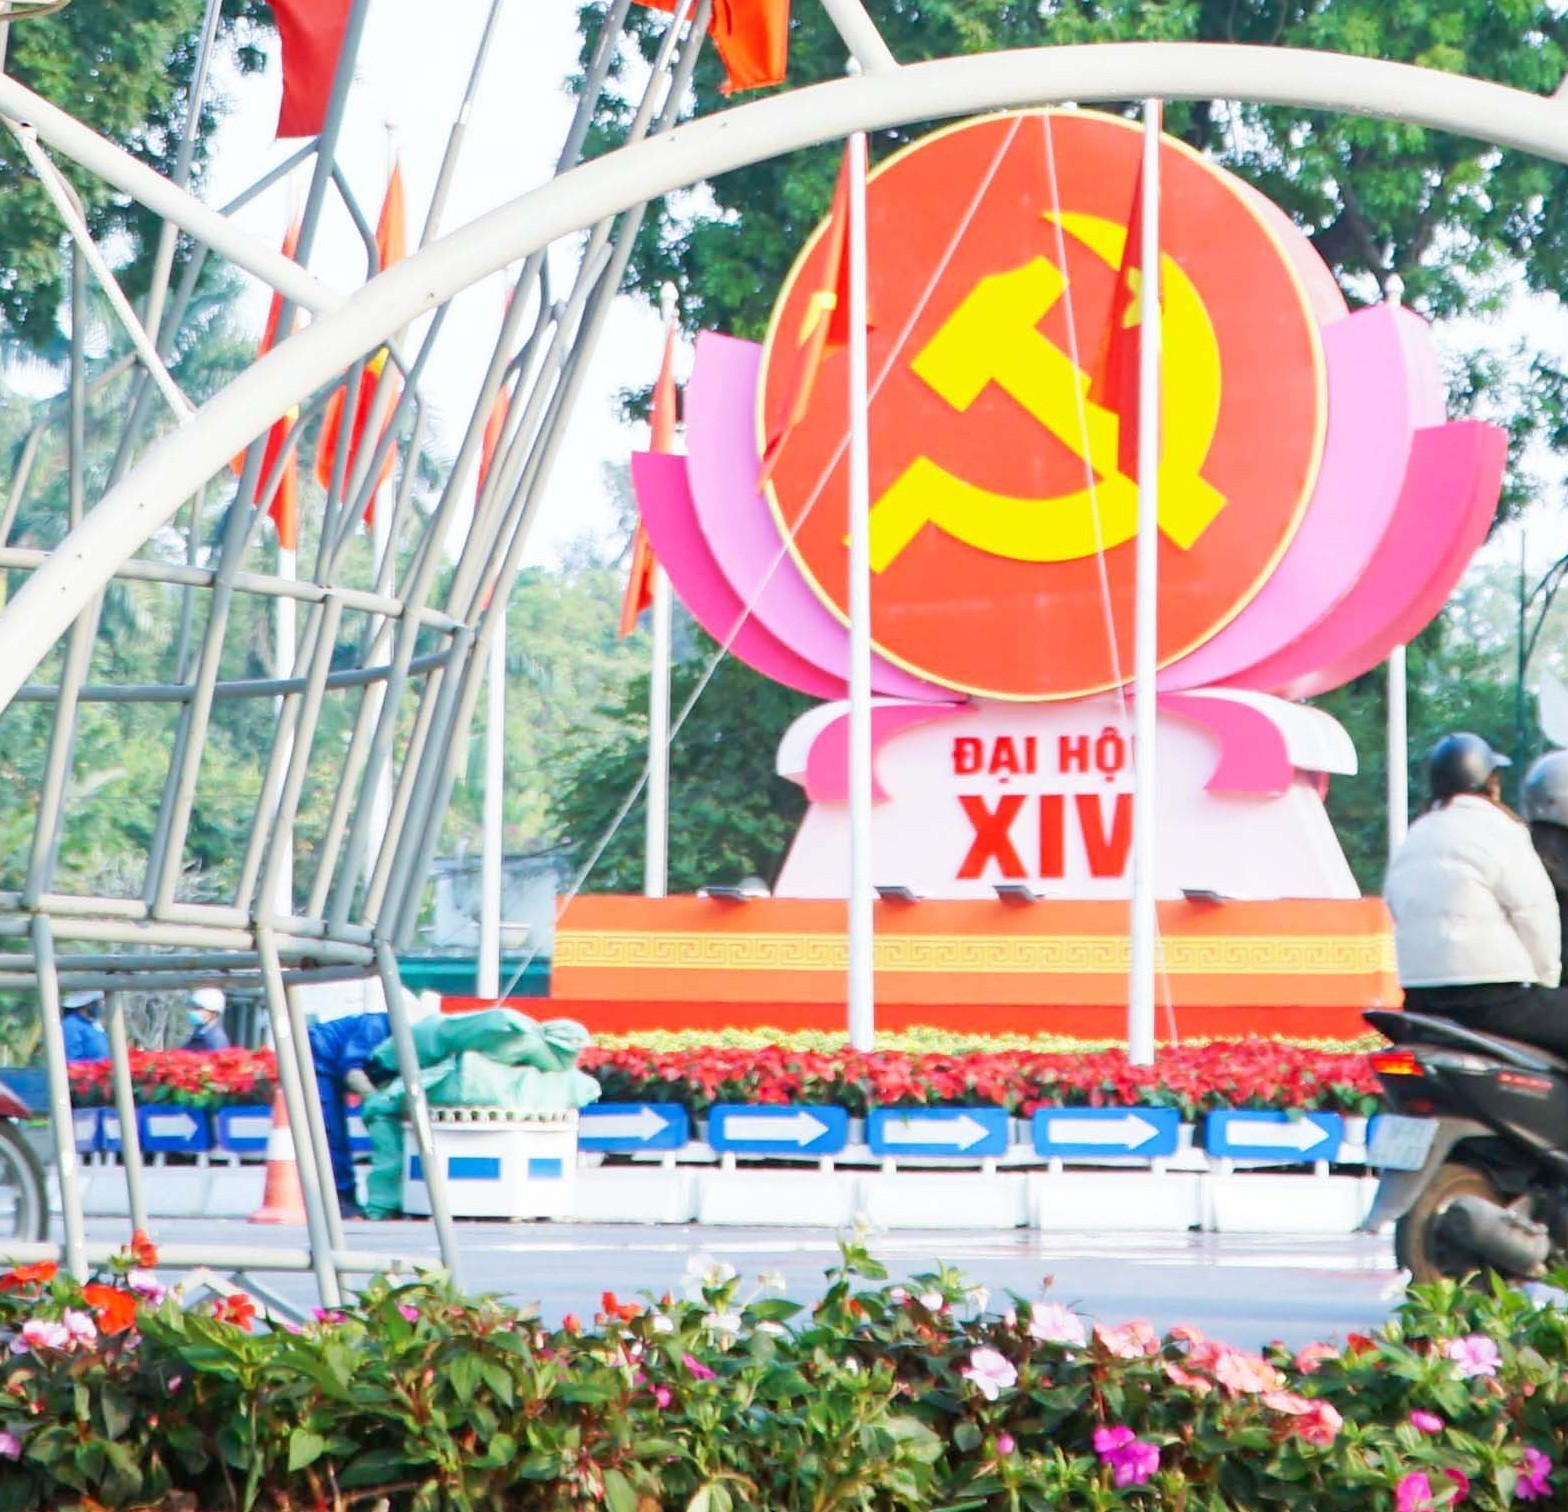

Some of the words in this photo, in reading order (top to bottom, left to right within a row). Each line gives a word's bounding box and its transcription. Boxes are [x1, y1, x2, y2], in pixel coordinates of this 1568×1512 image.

[953, 735, 1037, 784] ĐẠI
[1058, 726, 1136, 783] HỘ
[955, 793, 1135, 880] XIV
